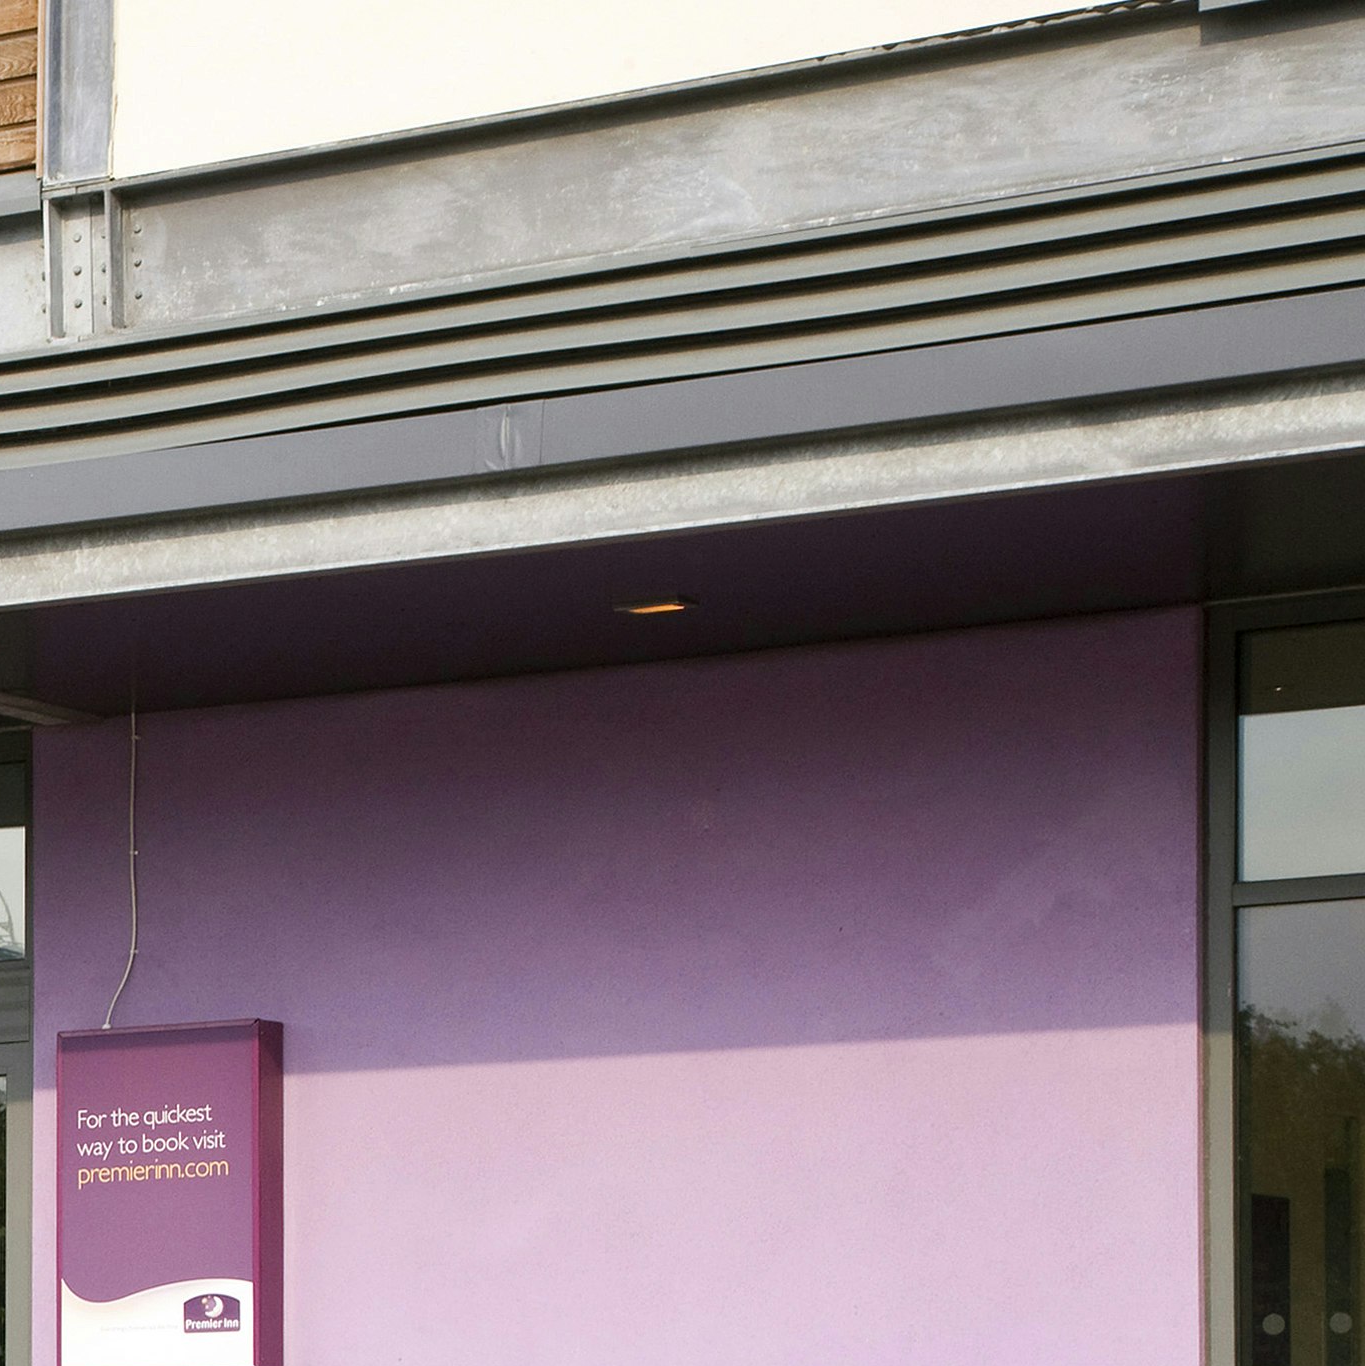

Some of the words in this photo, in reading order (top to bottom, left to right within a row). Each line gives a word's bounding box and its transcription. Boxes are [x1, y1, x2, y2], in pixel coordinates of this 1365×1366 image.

[77, 1109, 106, 1129] For
[110, 1107, 140, 1127] the
[143, 1104, 212, 1130] quickest
[76, 1140, 113, 1161] way
[117, 1136, 138, 1155] to
[142, 1131, 189, 1153] book
[192, 1129, 226, 1150] visit
[77, 1158, 229, 1190] premierinn.com
[185, 1318, 223, 1330] Premier
[223, 1317, 239, 1328] Inn
